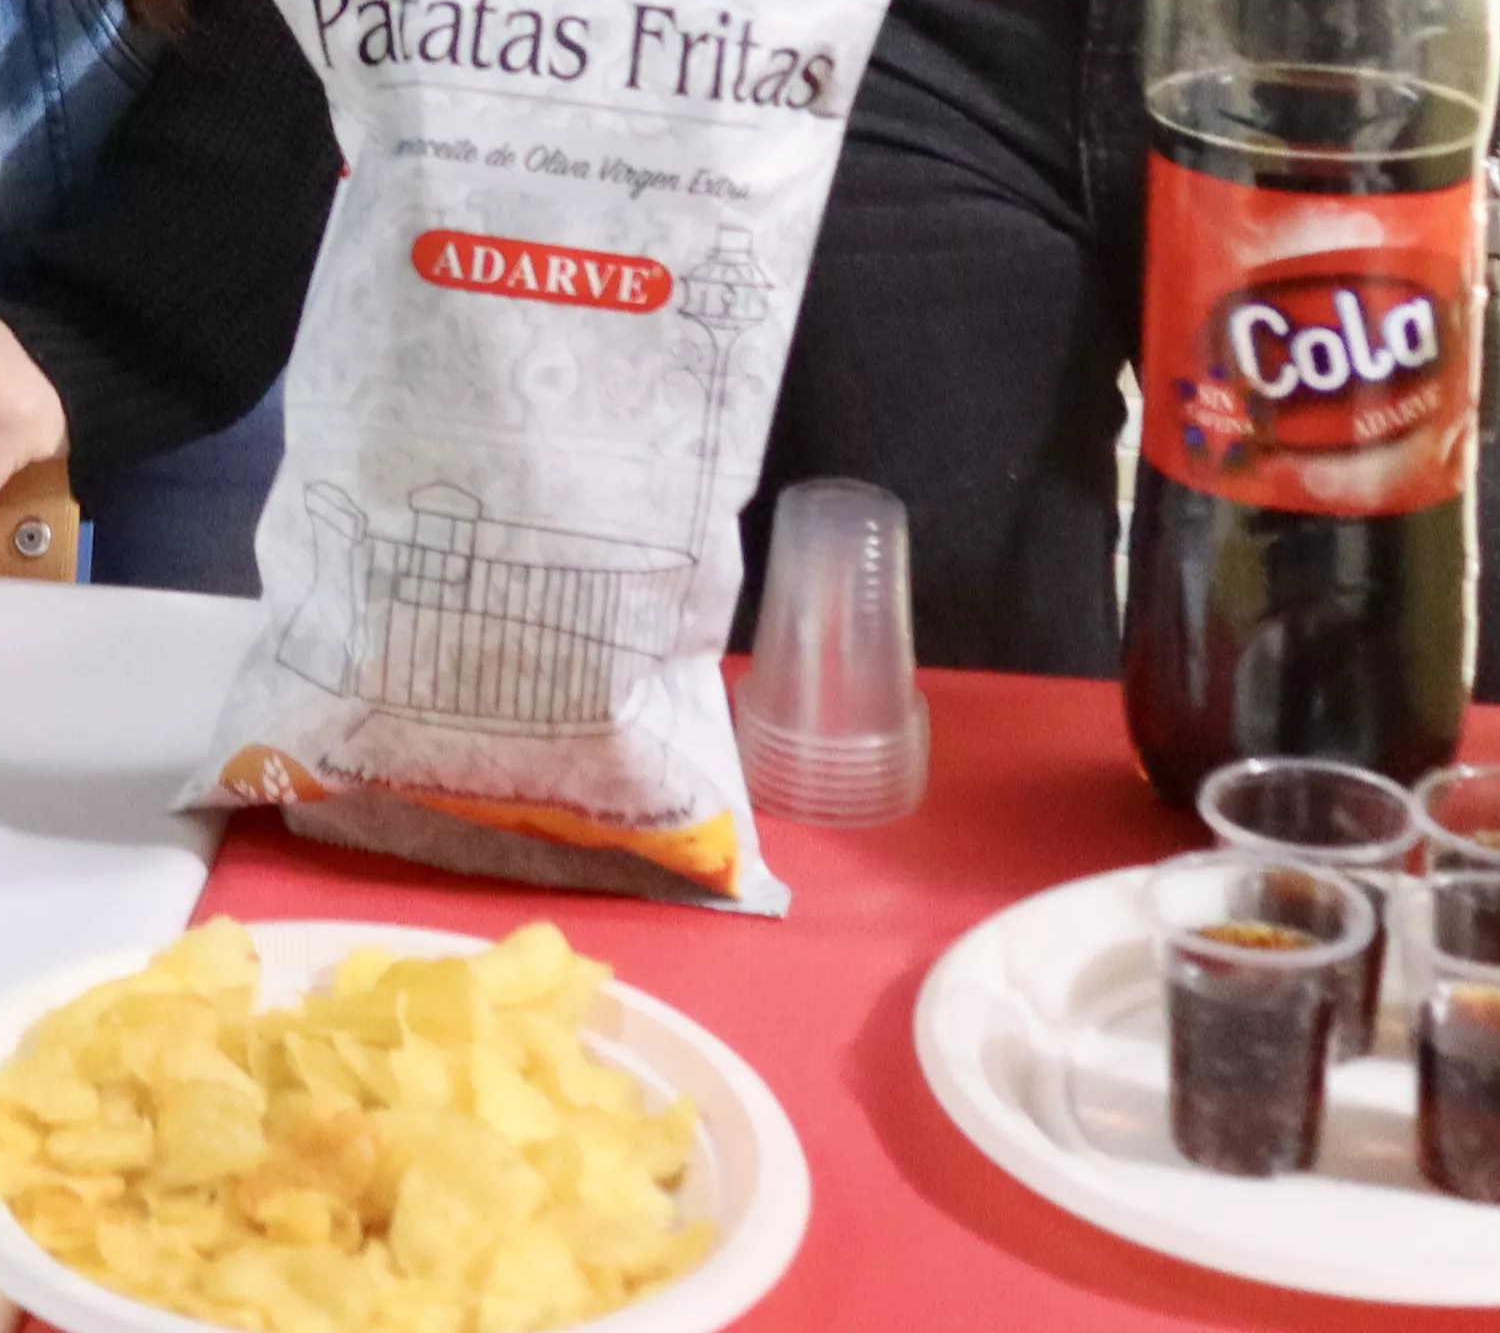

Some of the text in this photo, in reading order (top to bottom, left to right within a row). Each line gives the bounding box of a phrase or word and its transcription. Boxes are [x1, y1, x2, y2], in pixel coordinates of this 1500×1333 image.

[623, 2, 838, 115] Fritas
[525, 144, 590, 180] Oliva
[599, 156, 680, 200] Virgen
[431, 240, 652, 306] ADARVE
[1229, 289, 1440, 399] Cola
